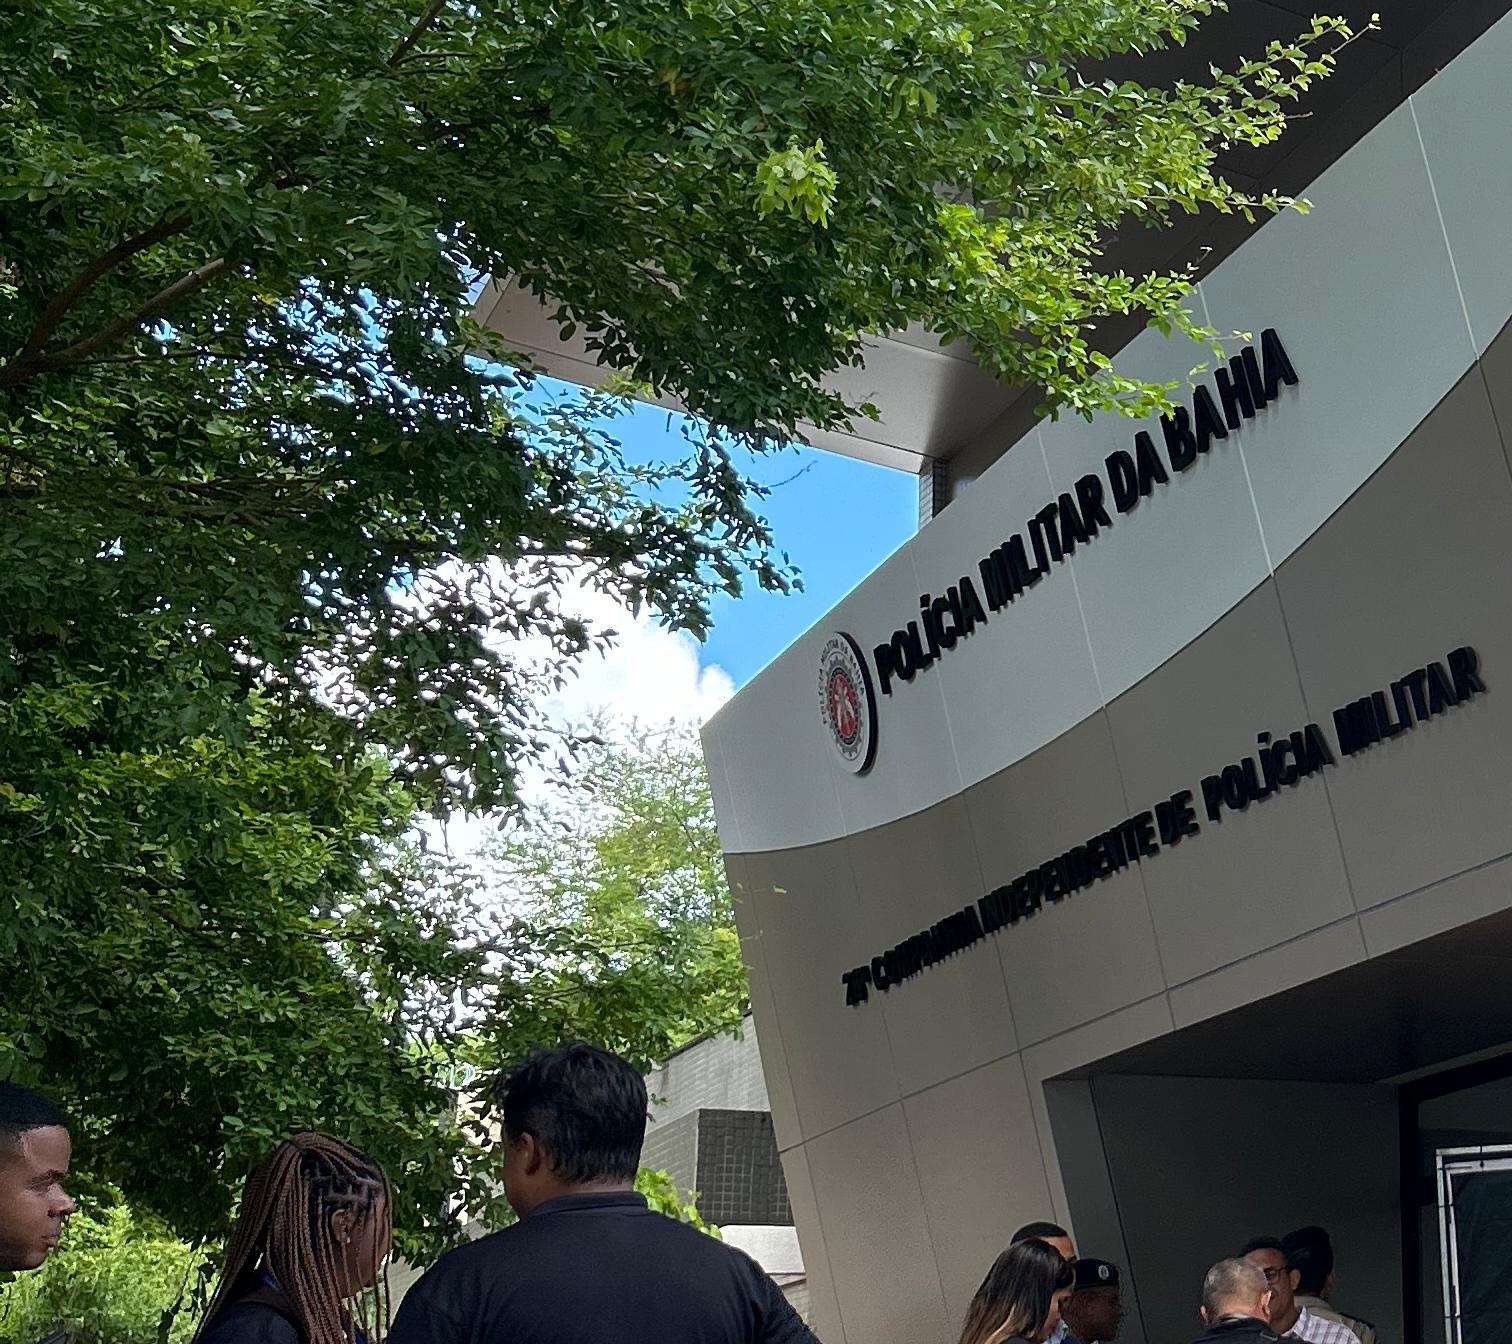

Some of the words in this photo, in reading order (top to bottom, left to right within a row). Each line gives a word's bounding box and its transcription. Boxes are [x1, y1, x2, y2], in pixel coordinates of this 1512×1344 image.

[874, 577, 986, 694] POLÍCIA
[979, 475, 1112, 611] MILITAR
[1105, 431, 1168, 513] DA
[1160, 329, 1298, 471] BAHIA
[1155, 790, 1200, 846] DE
[1202, 724, 1335, 822] POLÍCIA
[1333, 647, 1485, 757] MILITAR
